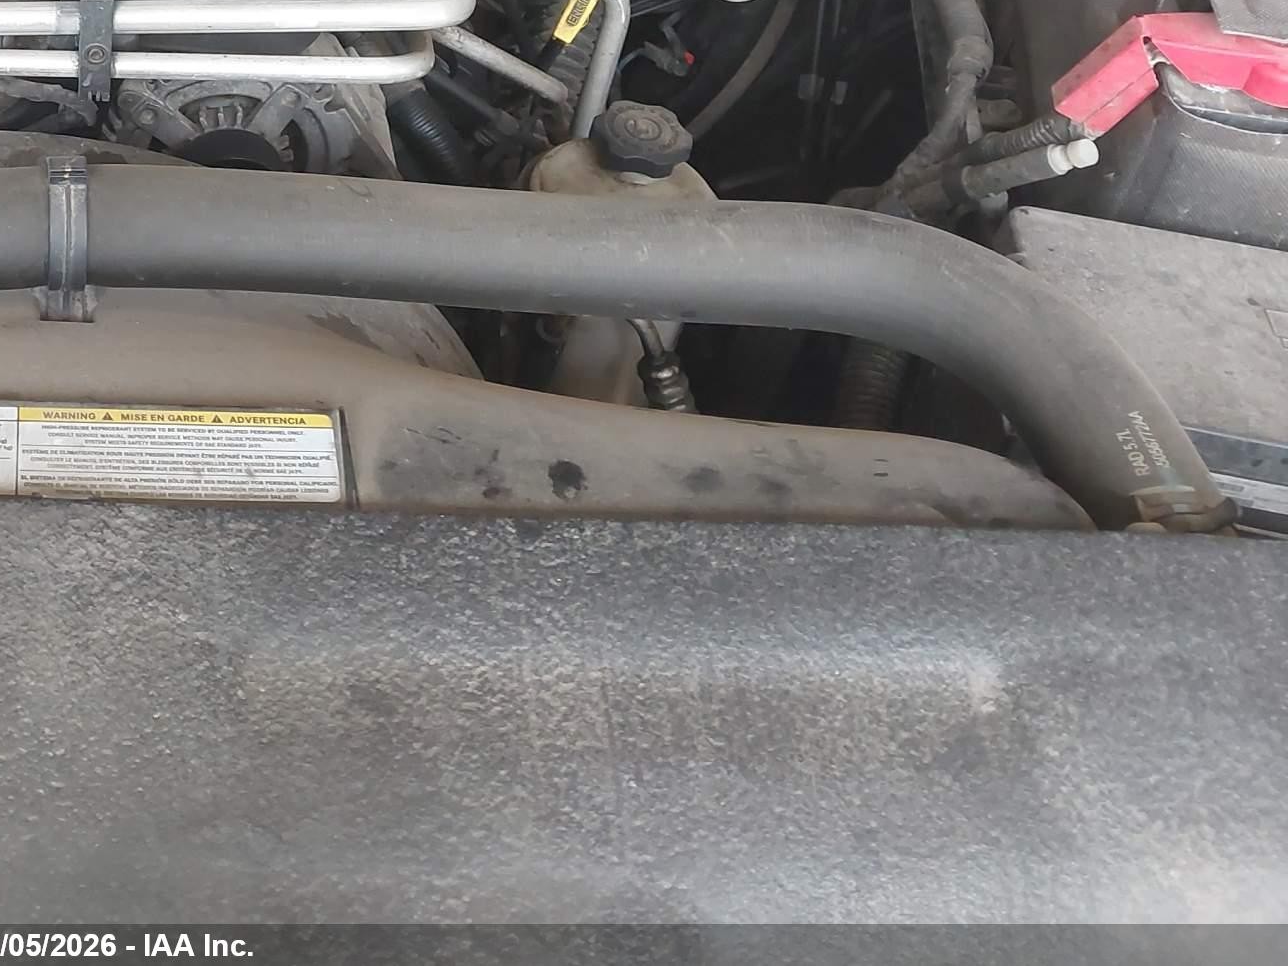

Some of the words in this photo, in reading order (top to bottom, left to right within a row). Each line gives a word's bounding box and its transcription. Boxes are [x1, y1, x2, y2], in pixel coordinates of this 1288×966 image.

[43, 411, 96, 421] WARNING
[121, 413, 148, 422] MISE
[150, 414, 165, 422] EN
[168, 414, 205, 423] GARDE
[229, 416, 307, 425] ADVERTENCIA
[1116, 428, 1138, 451] 5.7L
[1128, 451, 1151, 476] RAD
